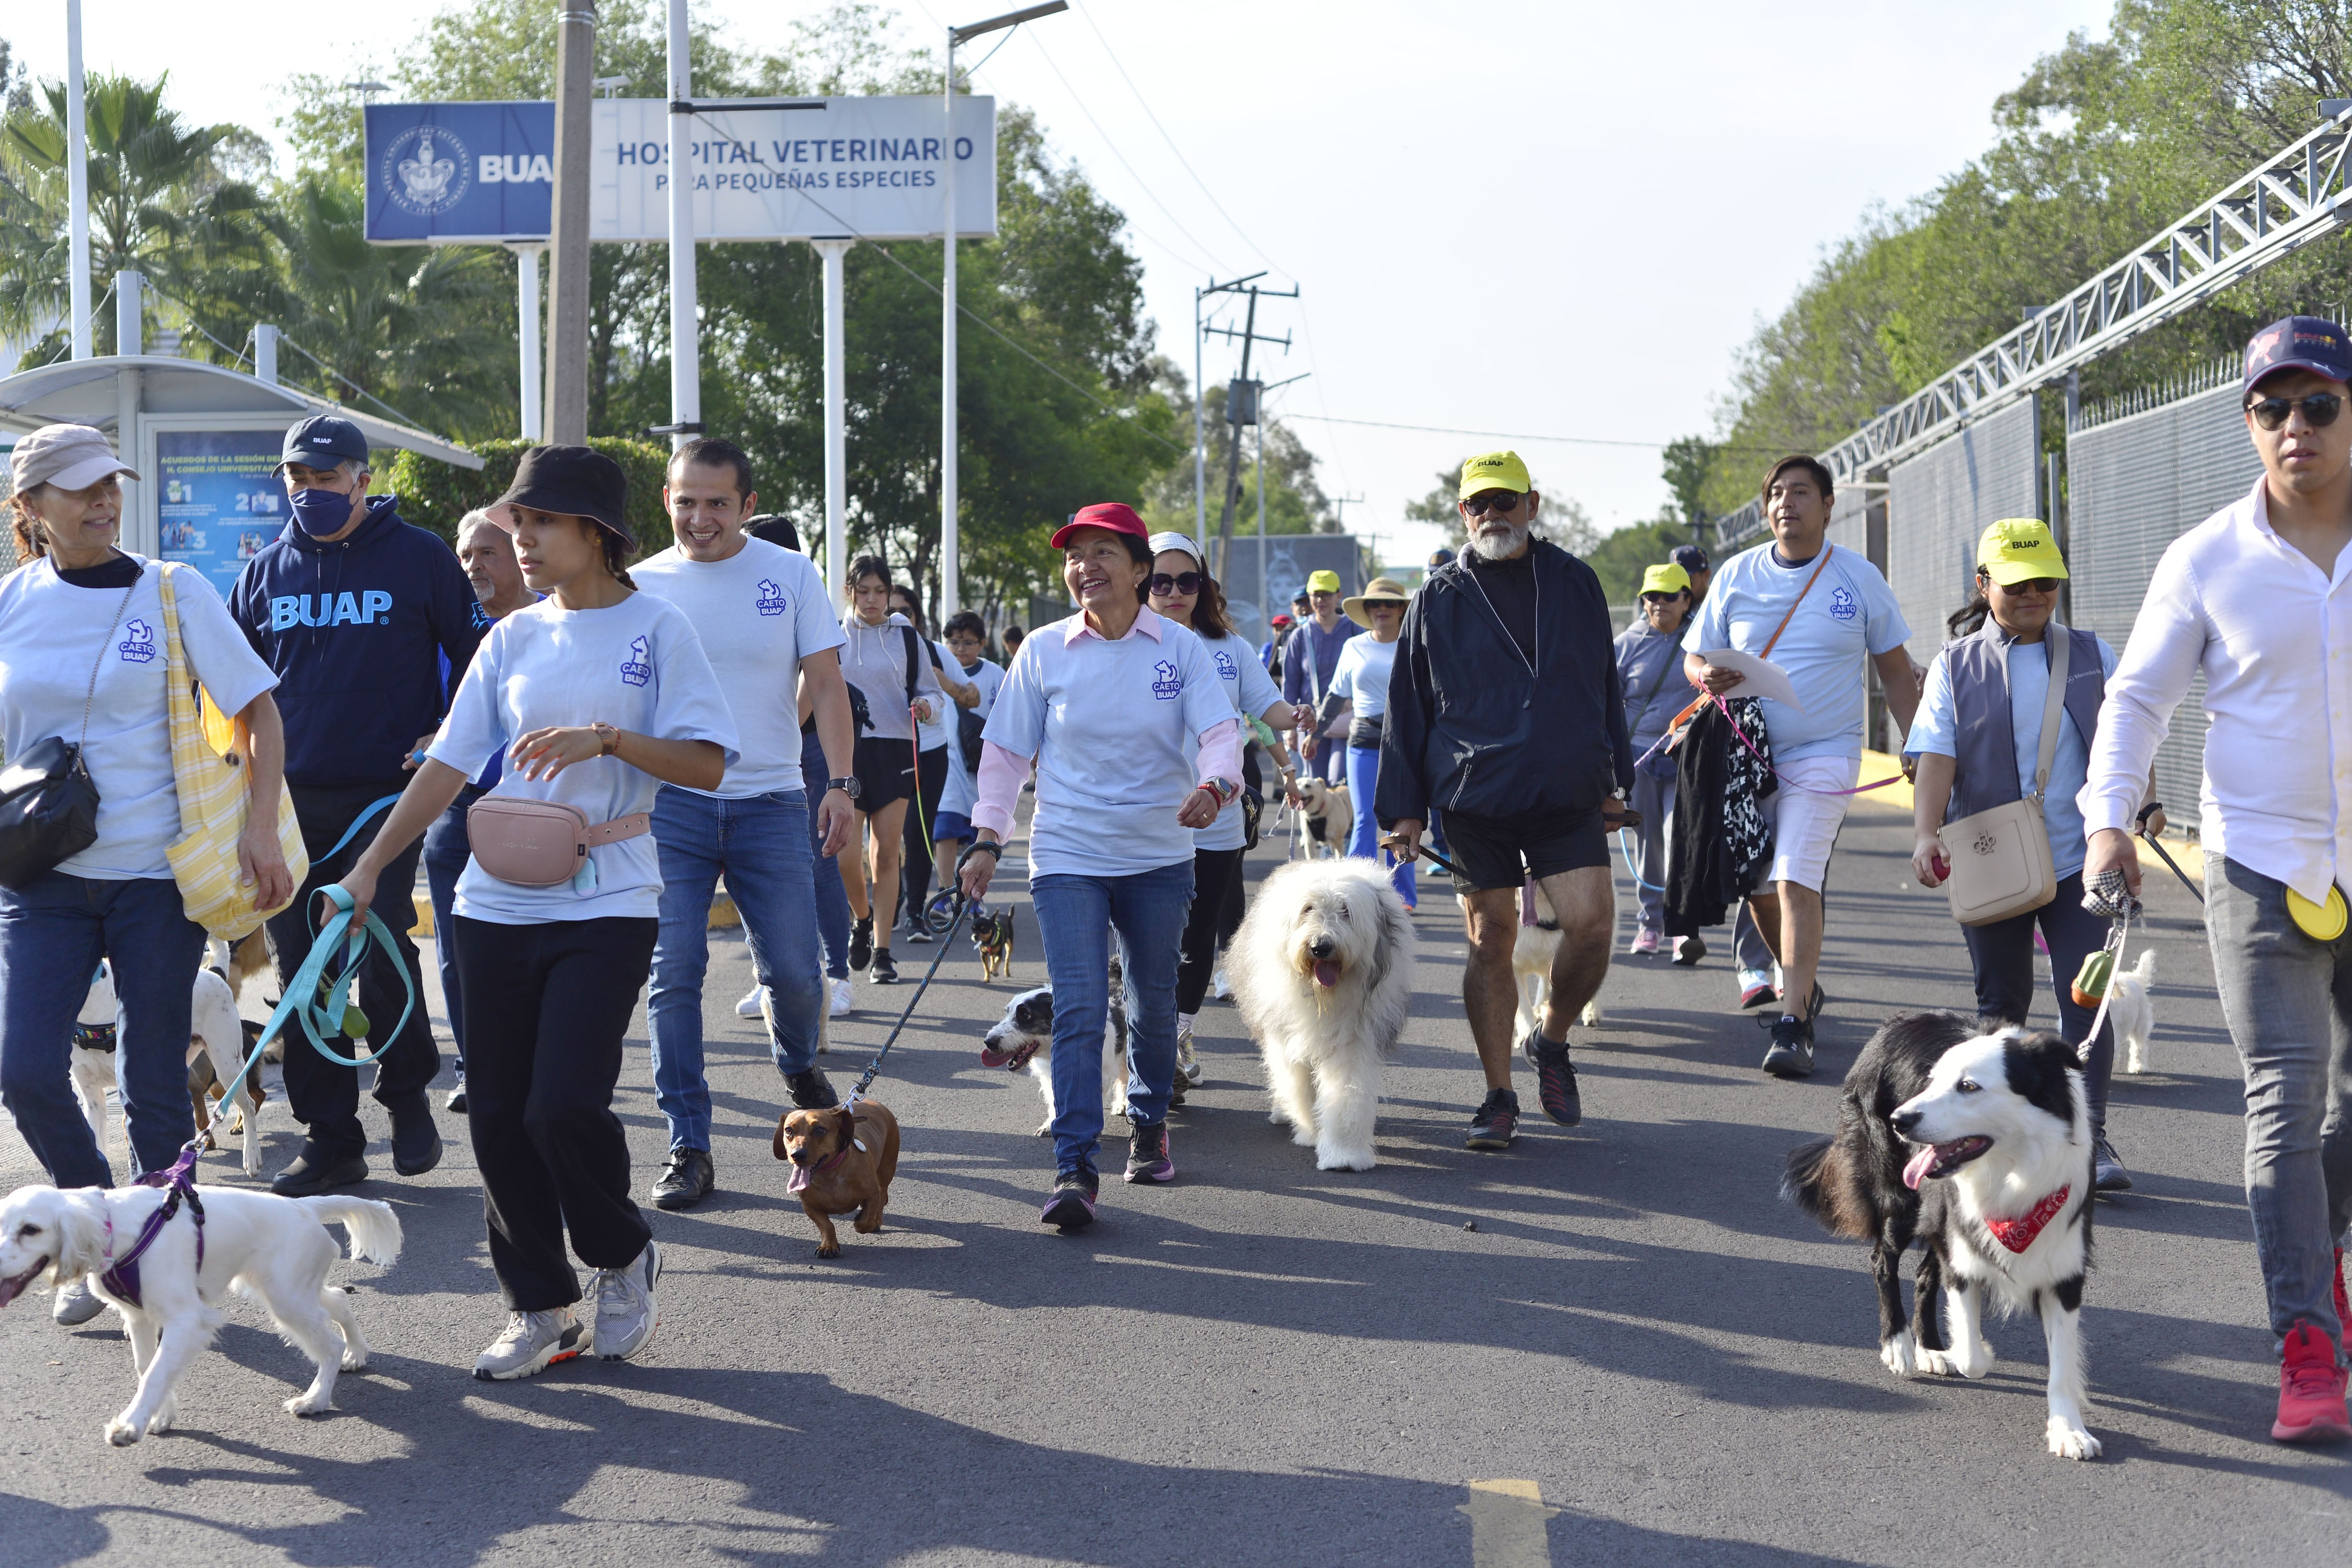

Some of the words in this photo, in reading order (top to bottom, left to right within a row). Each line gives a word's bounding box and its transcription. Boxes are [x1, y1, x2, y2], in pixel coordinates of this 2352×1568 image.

[618, 141, 764, 165] HOITAL
[773, 136, 974, 163] VETERINARIO
[479, 155, 553, 183] BUA
[655, 174, 709, 190] PA
[716, 167, 829, 193] PEQUEÑAS
[836, 170, 936, 188] ESPECIES
[160, 456, 206, 465] ACUERDOS
[207, 455, 220, 464] DE
[221, 455, 233, 464] LA
[234, 453, 265, 464] SESIÓN
[177, 465, 216, 474] CONSEJO
[217, 464, 277, 473] UNIVERSITAR
[183, 484, 192, 502] 1
[235, 492, 249, 511] 2
[192, 531, 206, 549] 3
[2012, 540, 2039, 549] BUAP
[757, 599, 785, 607] CAETO
[272, 590, 393, 632] BUAP
[120, 643, 155, 654] CAETO
[123, 652, 151, 662] BUAP
[622, 664, 649, 677] CAEO
[2073, 668, 2102, 679] Mercedes-Be
[1154, 682, 1180, 691] CAETO
